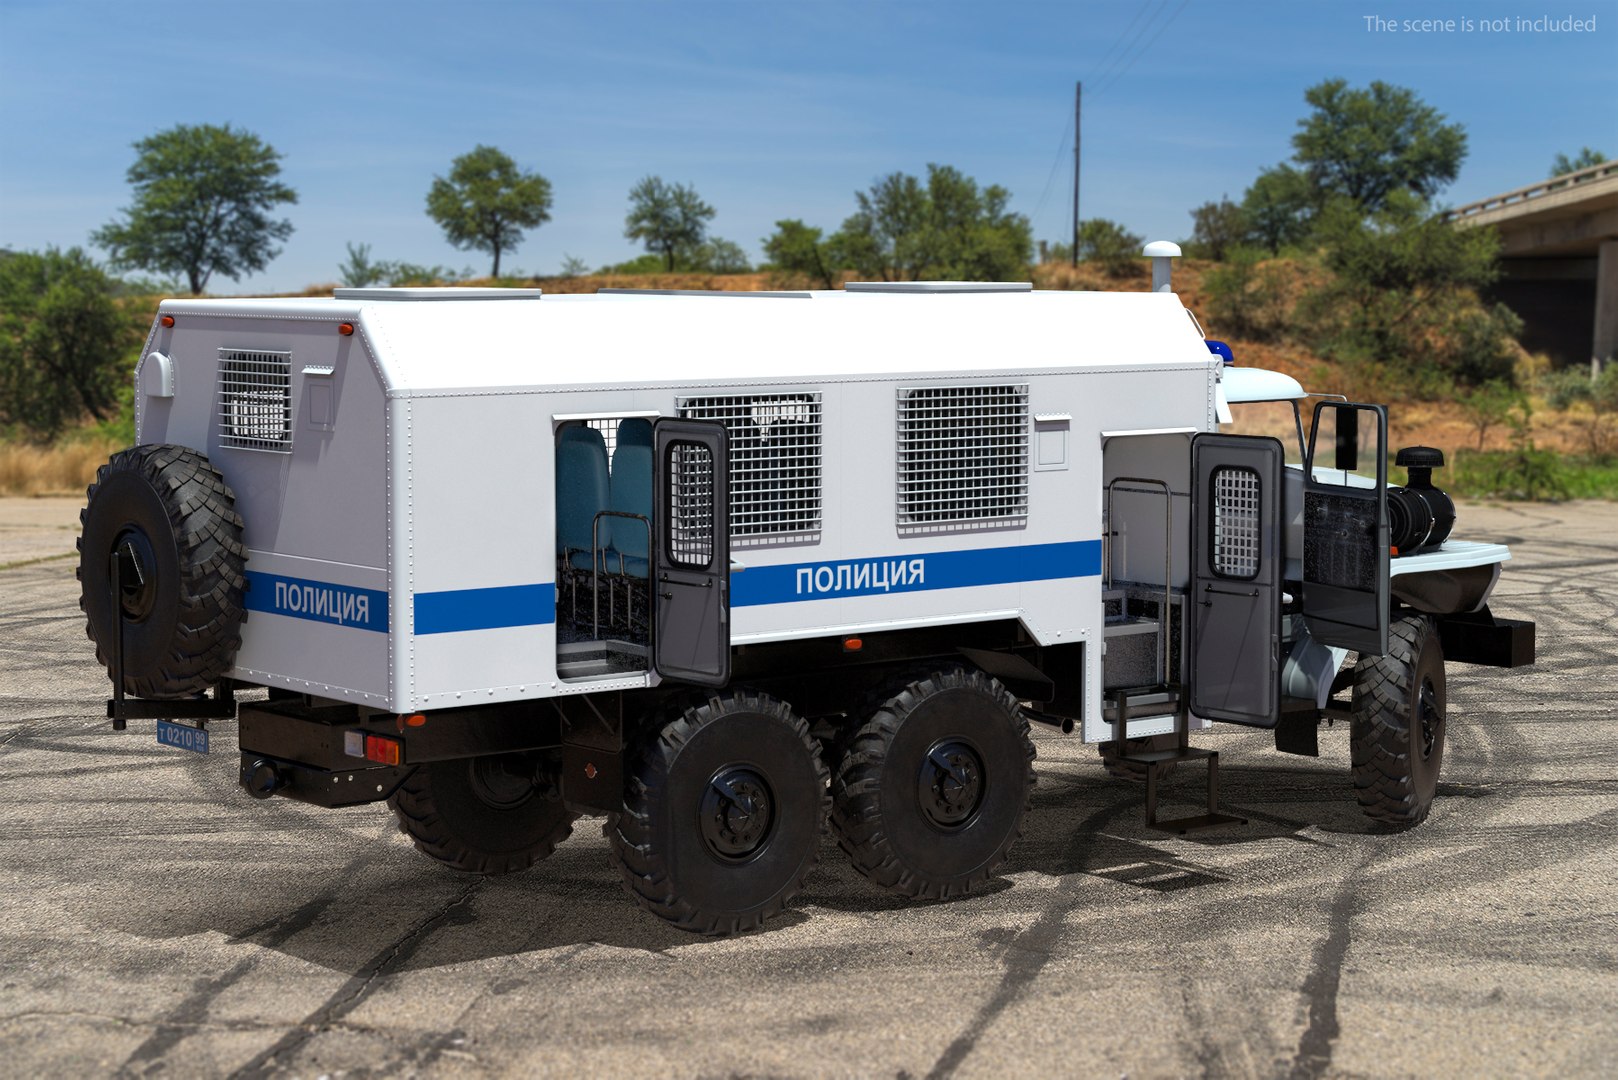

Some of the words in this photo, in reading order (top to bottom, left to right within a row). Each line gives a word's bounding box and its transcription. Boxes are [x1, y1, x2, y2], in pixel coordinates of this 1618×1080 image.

[796, 558, 925, 595] ПОЛИЦИЯ
[275, 581, 369, 624] ПОЛИЦИЯ
[166, 726, 193, 747] 0210
